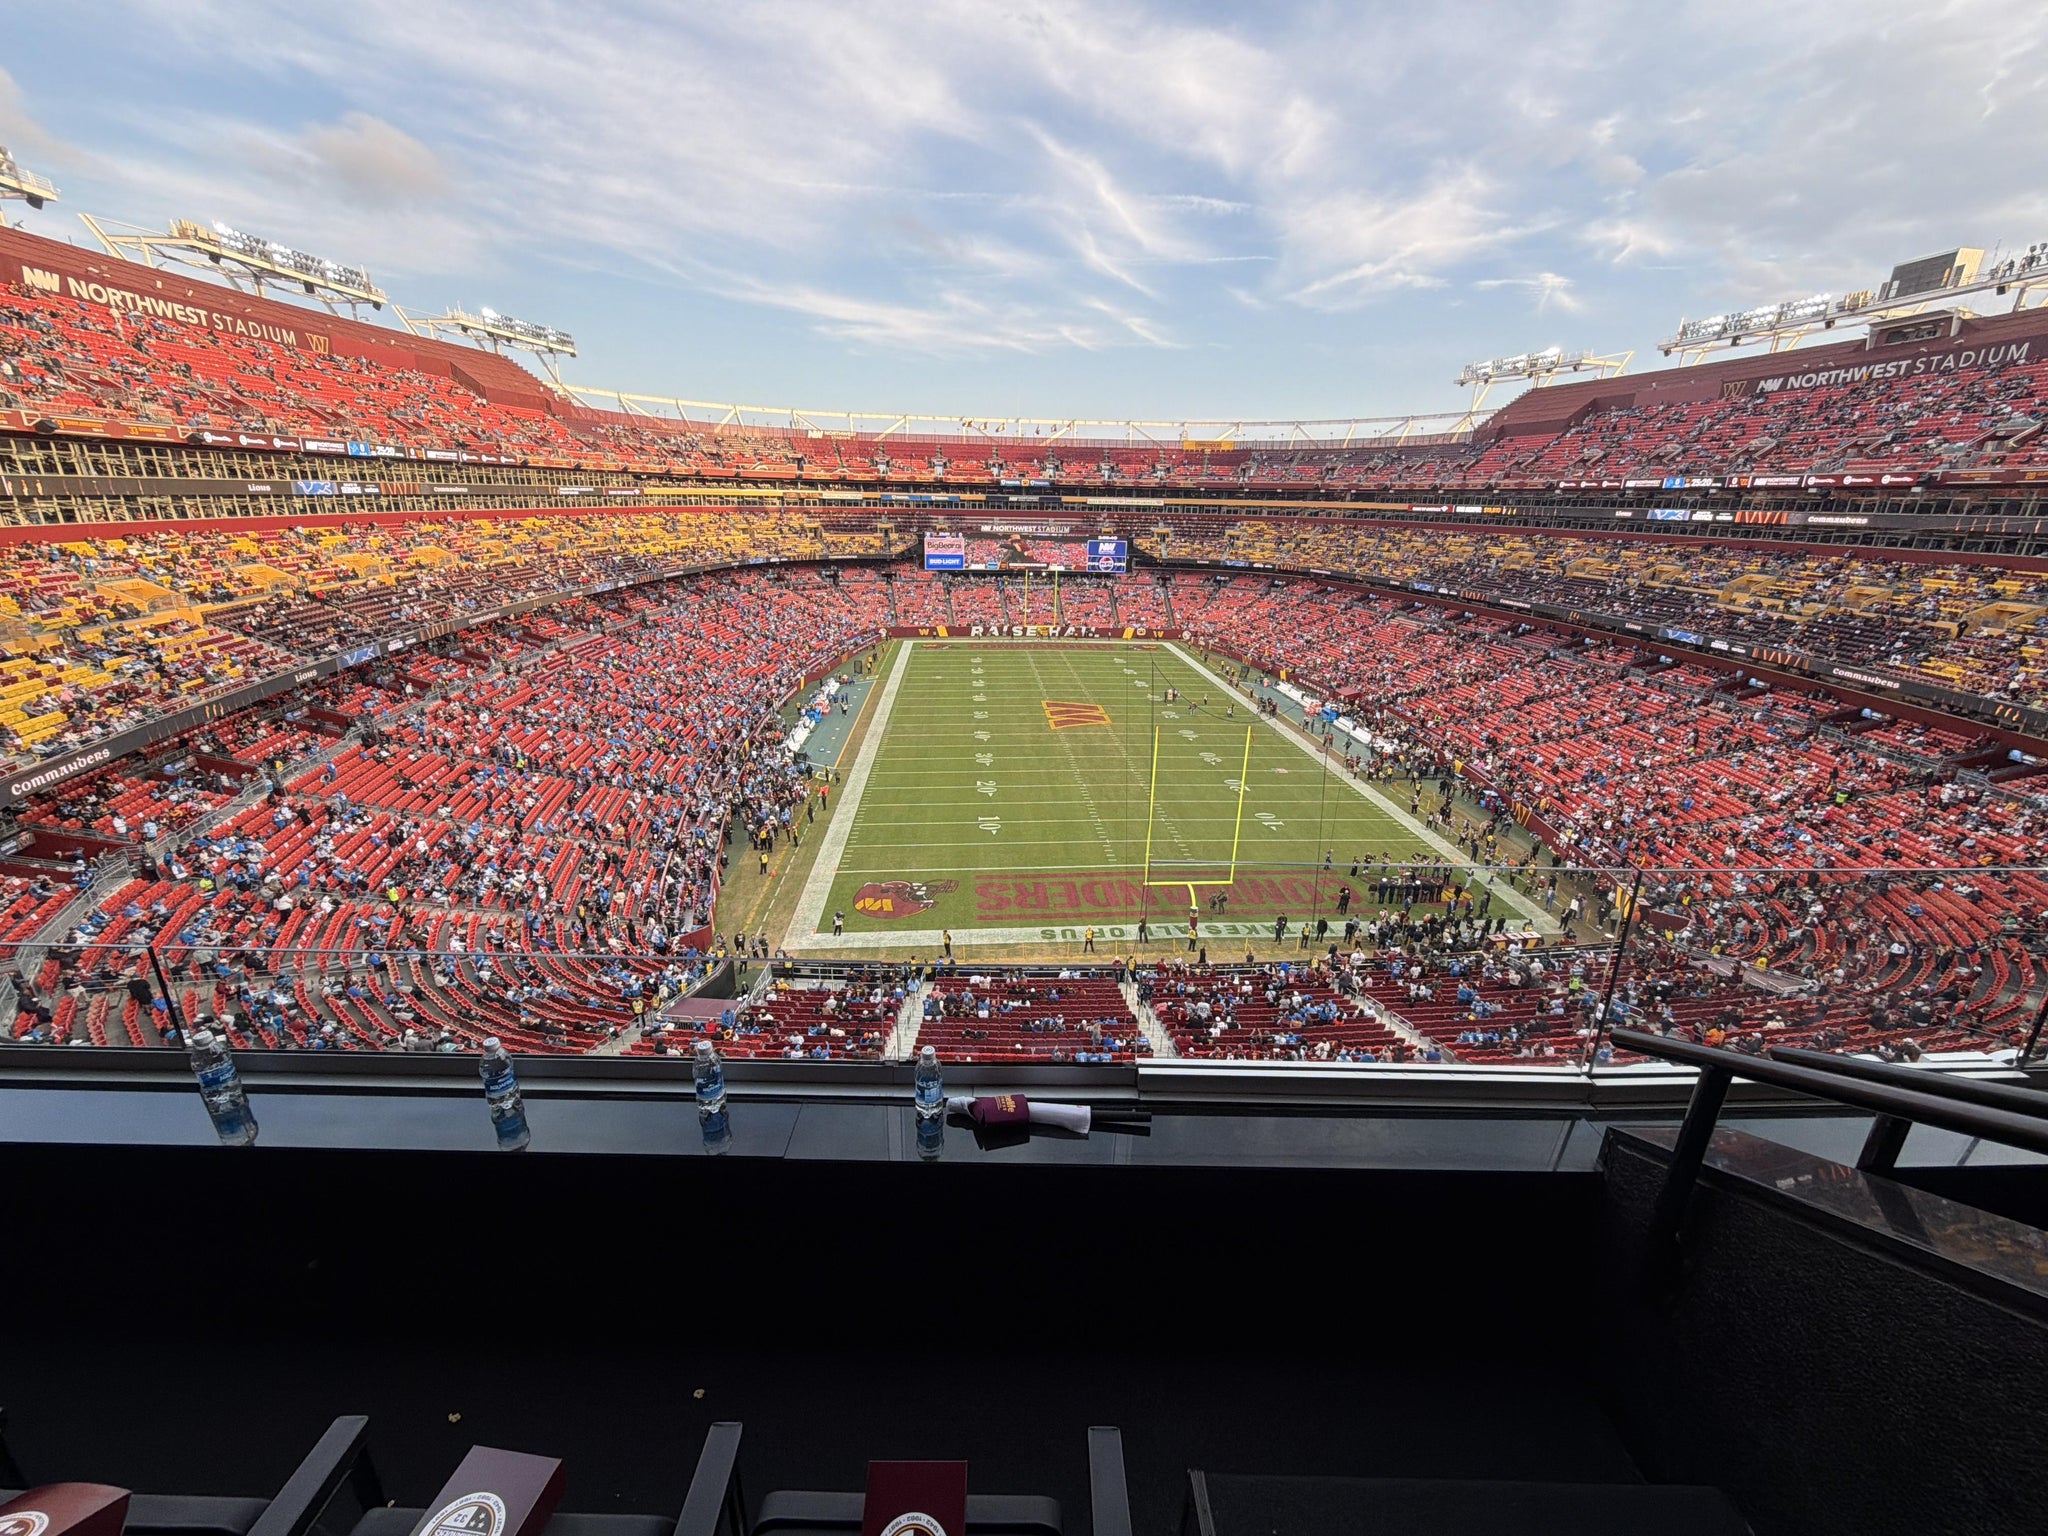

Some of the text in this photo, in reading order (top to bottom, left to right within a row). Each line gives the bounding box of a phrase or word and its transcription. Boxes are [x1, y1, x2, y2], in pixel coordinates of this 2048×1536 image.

[22, 265, 60, 293] NW
[67, 276, 208, 327] NORTHWEST
[212, 312, 297, 346] STADIUM
[1786, 360, 1912, 390] NORTHWEST
[1913, 342, 2030, 374] STADIUM
[1691, 478, 1713, 487] 25:20
[993, 524, 1036, 533] NORTHWEST
[1037, 525, 1070, 534] STADIUM
[927, 541, 962, 550] BigBear.ai
[970, 625, 1038, 638] RAISE
[294, 668, 318, 683] Lions
[975, 752, 994, 763] 30
[976, 780, 998, 794] 20
[977, 815, 1002, 831] 10
[1254, 812, 1285, 827] 10
[1040, 928, 1077, 941] US
[453, 1513, 468, 1524] 32
